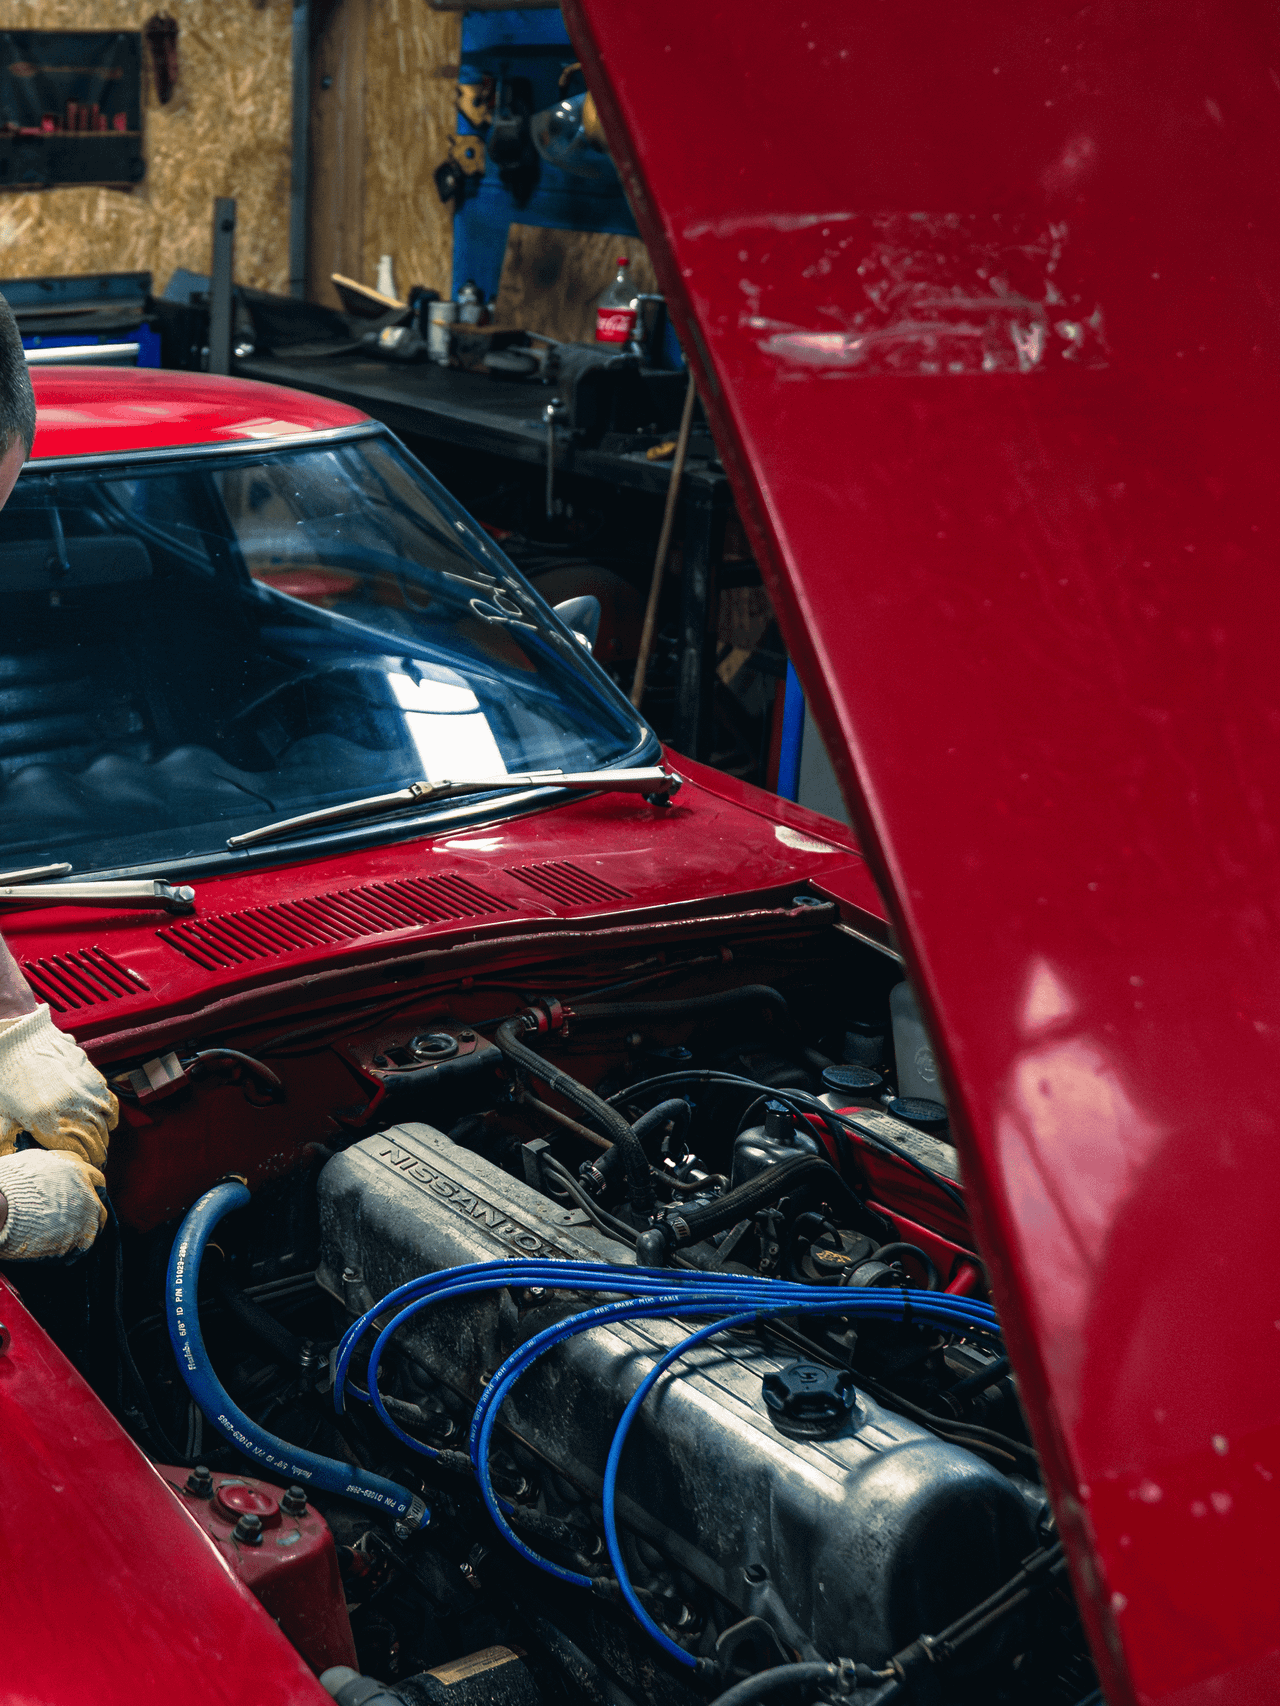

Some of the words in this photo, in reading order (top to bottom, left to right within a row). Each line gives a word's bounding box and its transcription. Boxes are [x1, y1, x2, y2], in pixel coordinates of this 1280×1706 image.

[379, 1148, 507, 1229] NISSAN
[175, 1288, 183, 1303] P/N
[659, 1294, 680, 1303] CABLE
[176, 1306, 184, 1316] ID
[217, 1414, 254, 1449] D1029-2965
[252, 1446, 266, 1457] P/N
[384, 1497, 397, 1508] P/N
